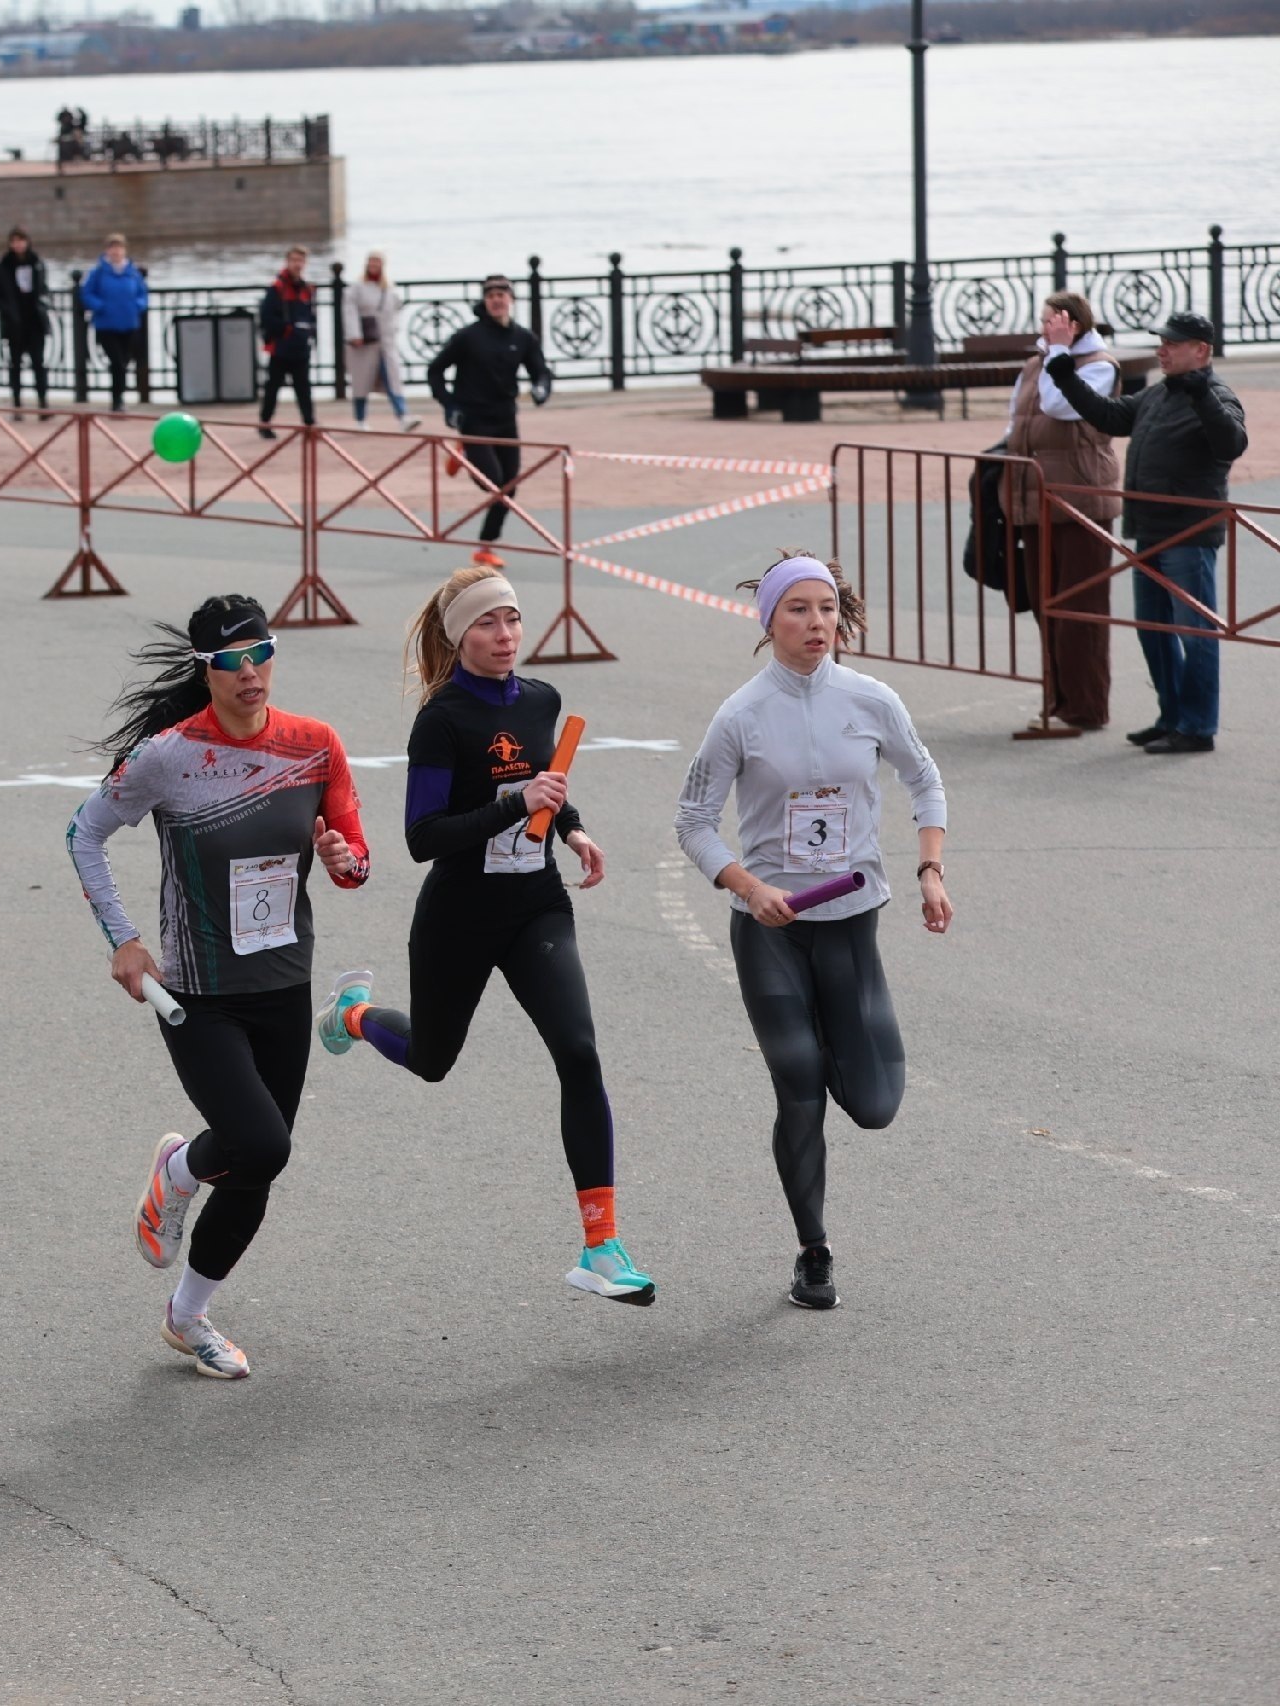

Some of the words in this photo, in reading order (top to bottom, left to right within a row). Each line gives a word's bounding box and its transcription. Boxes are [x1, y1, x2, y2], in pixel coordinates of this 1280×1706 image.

[491, 762, 532, 775] ПАЛЕСТРА
[807, 818, 828, 847] 3
[252, 889, 271, 921] 8
